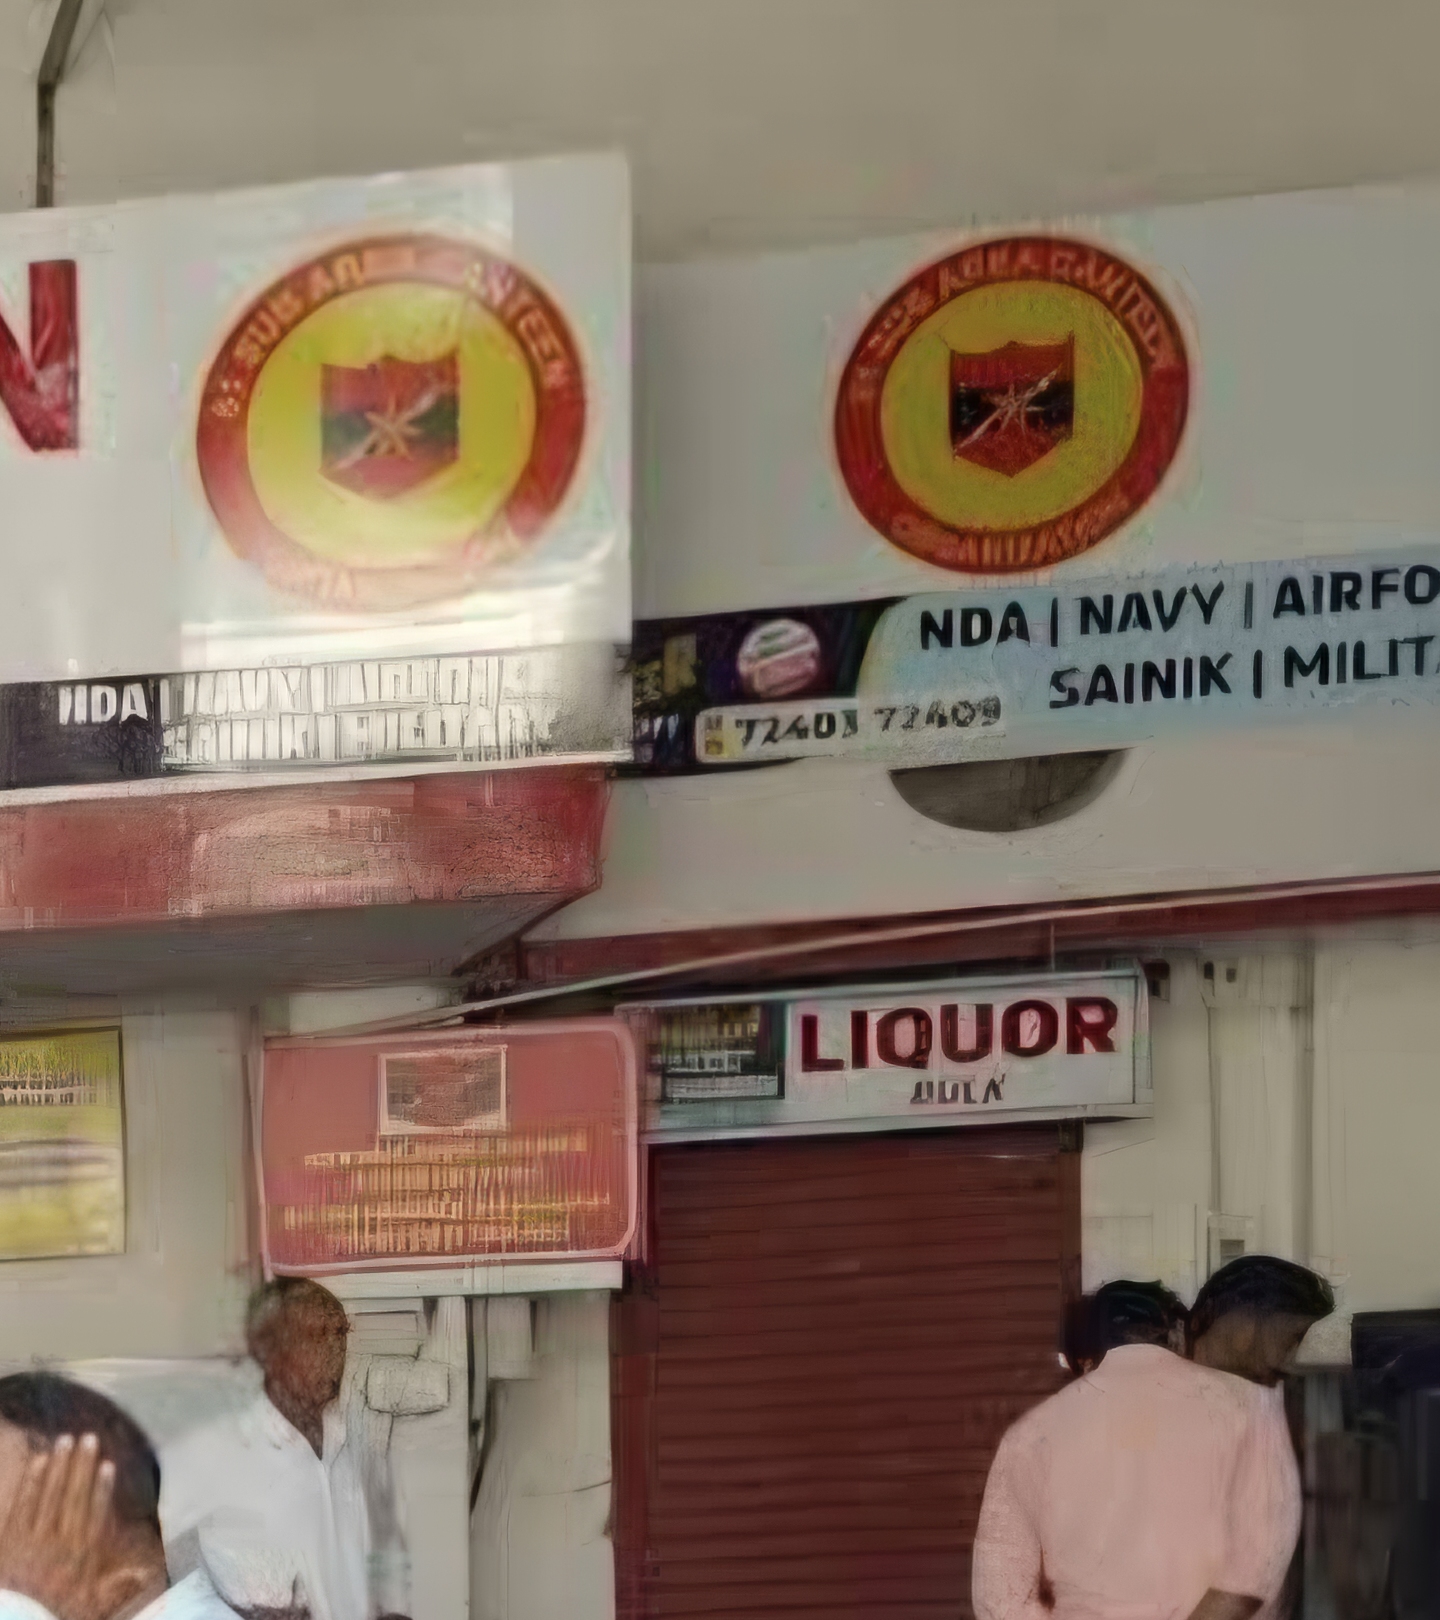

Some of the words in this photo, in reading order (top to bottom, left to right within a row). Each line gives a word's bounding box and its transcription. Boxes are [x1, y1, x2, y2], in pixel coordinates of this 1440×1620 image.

[920, 601, 1029, 650] NDA
[1080, 580, 1224, 634] NAVY
[1049, 652, 1233, 708] SAINIK
[1284, 635, 1440, 688] MILIT
[802, 996, 1118, 1072] LIQUOR
